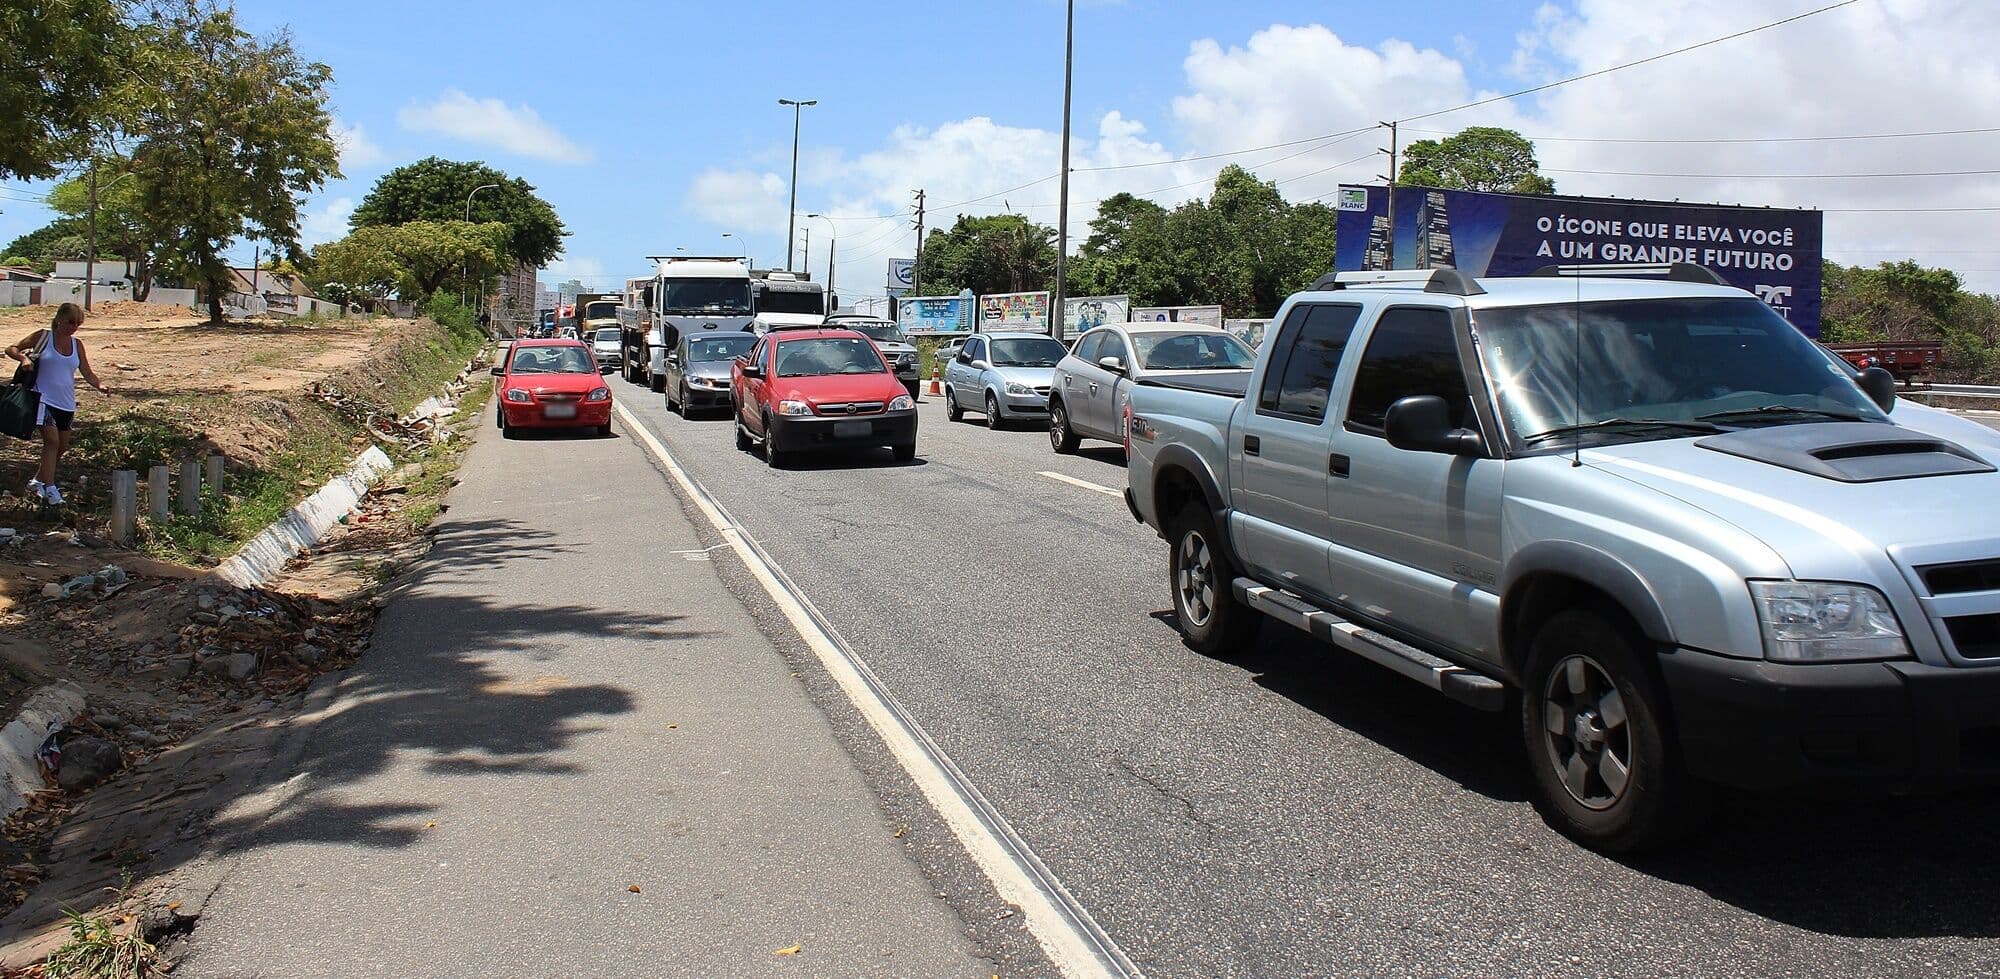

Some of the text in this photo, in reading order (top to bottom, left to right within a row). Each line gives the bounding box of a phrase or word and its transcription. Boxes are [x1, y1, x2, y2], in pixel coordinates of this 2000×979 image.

[1537, 215, 1793, 246] O ÍCONE QUE ELEVA VOCÊ
[1536, 240, 1793, 271] A UM GRANDE FUTURO
